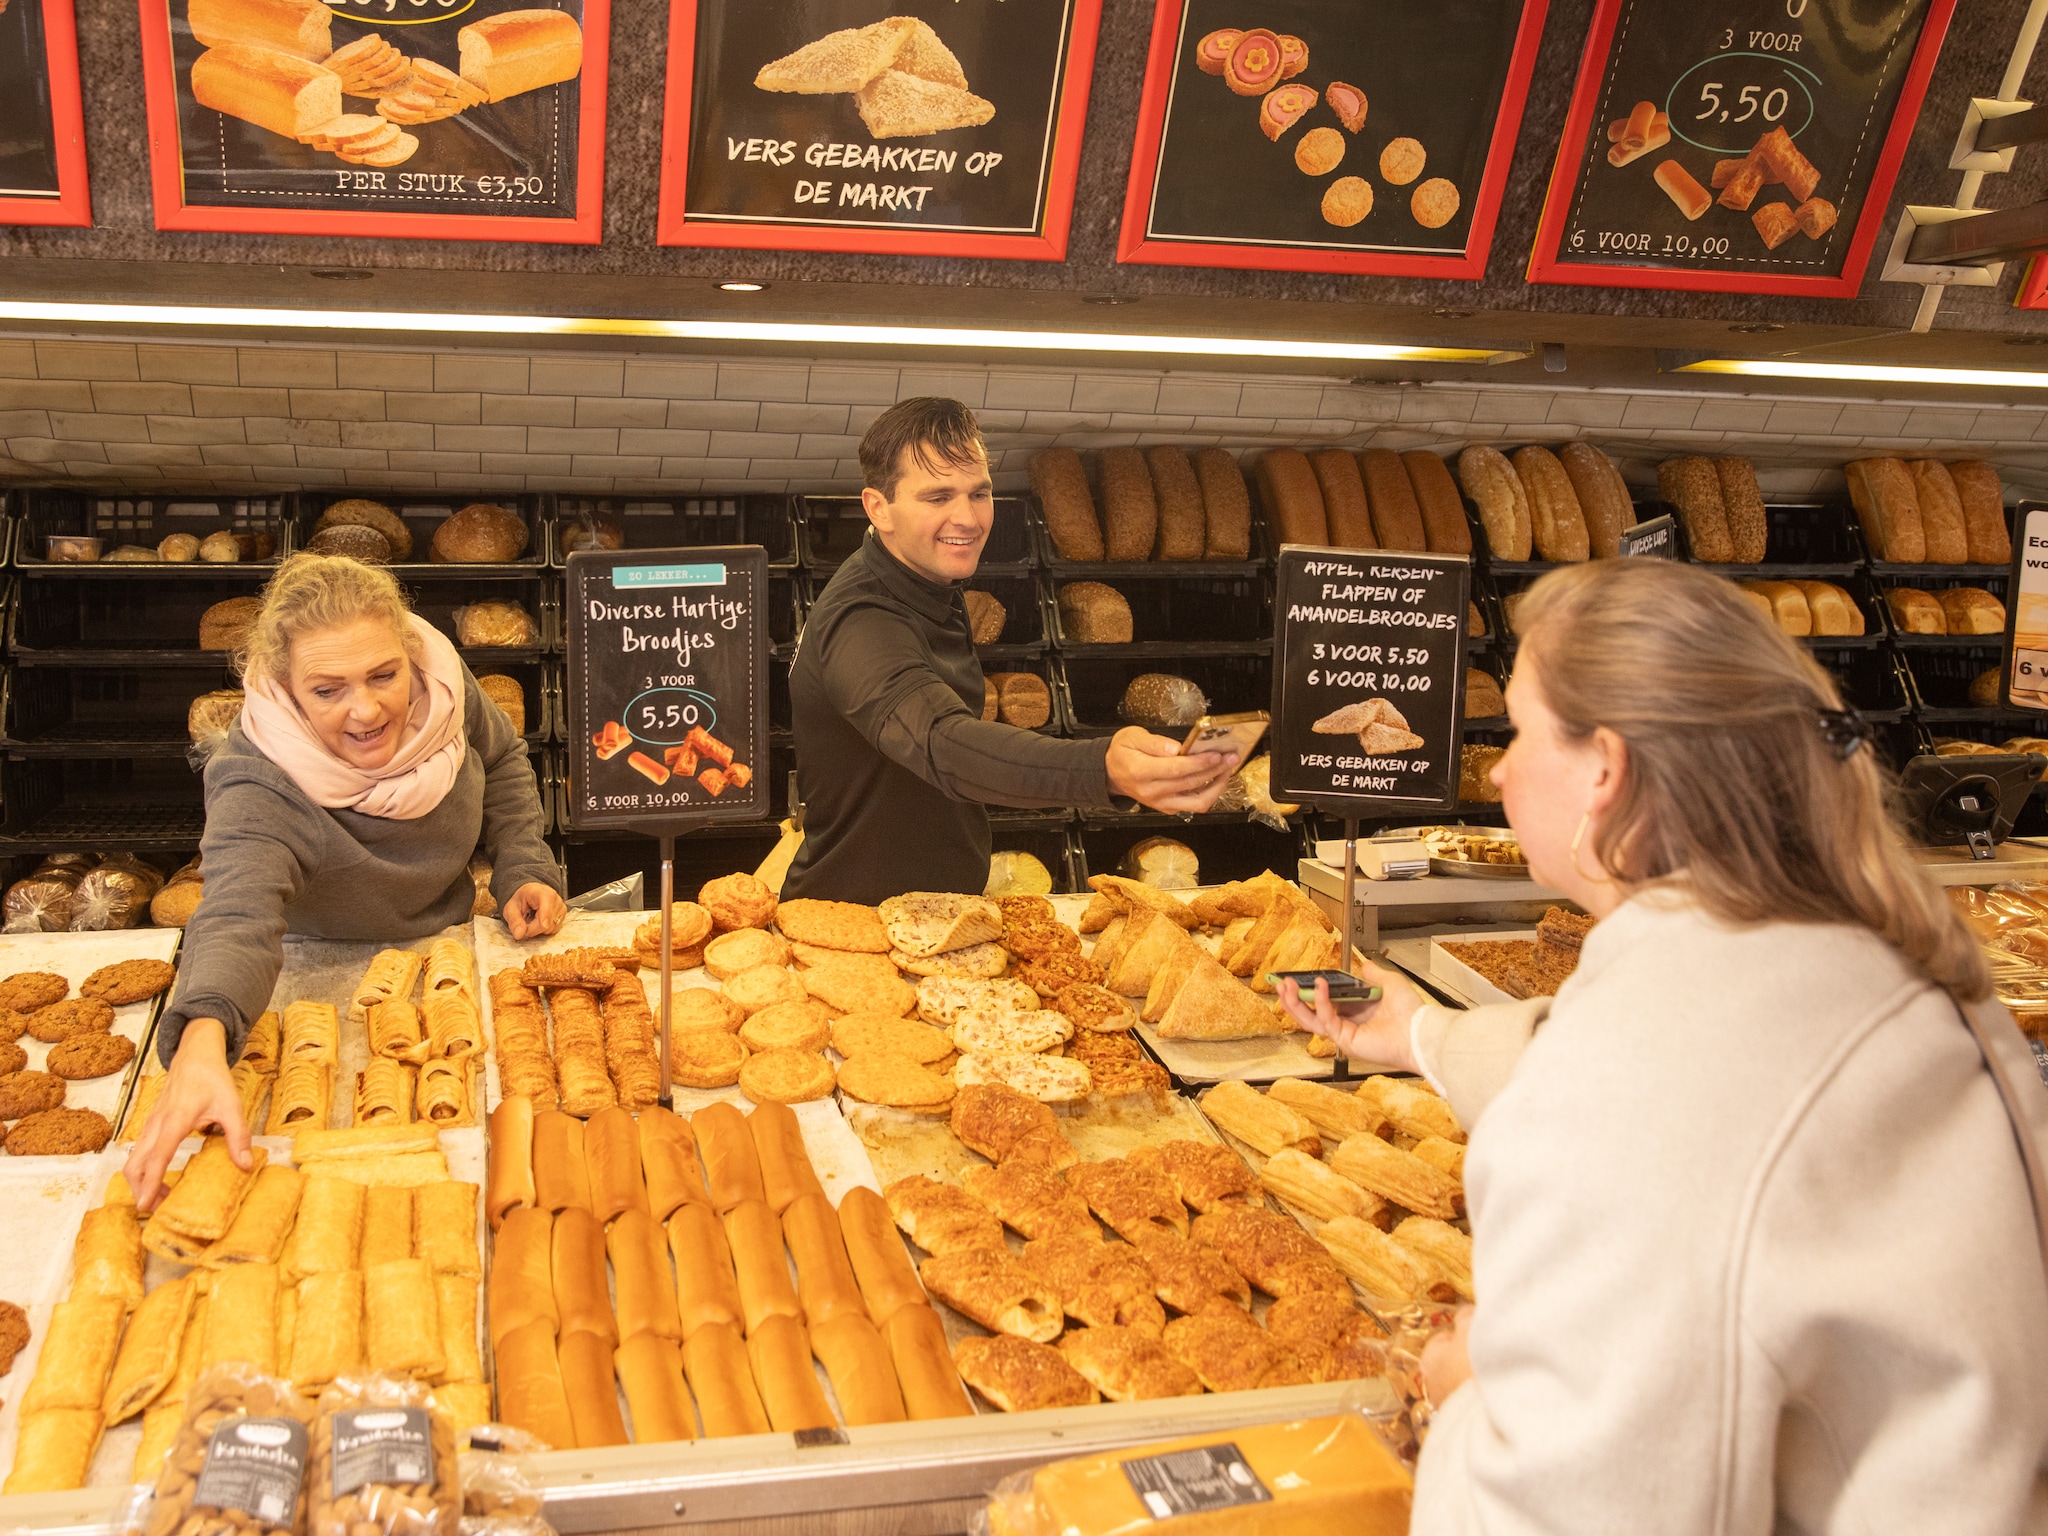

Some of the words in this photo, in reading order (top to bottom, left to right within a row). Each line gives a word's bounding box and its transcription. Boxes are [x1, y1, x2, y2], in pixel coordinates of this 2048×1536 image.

[1720, 28, 1734, 51] 3
[1749, 31, 1803, 53] VOOR
[1695, 82, 1789, 124] 5,50
[727, 137, 797, 167] VERS
[804, 143, 958, 173] GEBAKKEN
[964, 151, 1003, 177] OP
[336, 170, 387, 191] PER
[398, 174, 466, 194] STUK
[477, 175, 544, 199] €3,50
[793, 180, 832, 204] DE
[838, 182, 934, 212] MARKT
[1573, 229, 1585, 249] 6
[1598, 231, 1652, 253] VOOR
[1661, 234, 1730, 258] 10,00
[628, 572, 643, 581] ZO
[1304, 561, 1364, 579] APPEL,
[1322, 584, 1398, 603] FLAPPEN
[1402, 588, 1426, 605] OF
[590, 600, 666, 622] Diverse
[672, 595, 747, 630] Hartige
[1287, 604, 1457, 631] AMANDELBROODJES
[622, 626, 716, 668] Broodjes
[1312, 643, 1326, 660] 3
[1330, 644, 1383, 665] VOOR
[1387, 647, 1430, 666] 5,50
[2019, 662, 2032, 675] 6
[645, 676, 653, 689] 3
[660, 675, 695, 687] VOOR
[1307, 669, 1320, 686] 6
[1325, 670, 1378, 692] VOOR
[1381, 673, 1432, 693] 10,00
[642, 704, 699, 729] 5,50
[1300, 754, 1333, 768] VERS
[1335, 756, 1408, 773] GEBAKKEN
[1411, 760, 1430, 774] OP
[1331, 773, 1350, 787] DE
[1352, 775, 1398, 791] MARKT
[588, 797, 597, 807] 6
[604, 794, 640, 806] VOOR
[646, 792, 690, 806] 10,00
